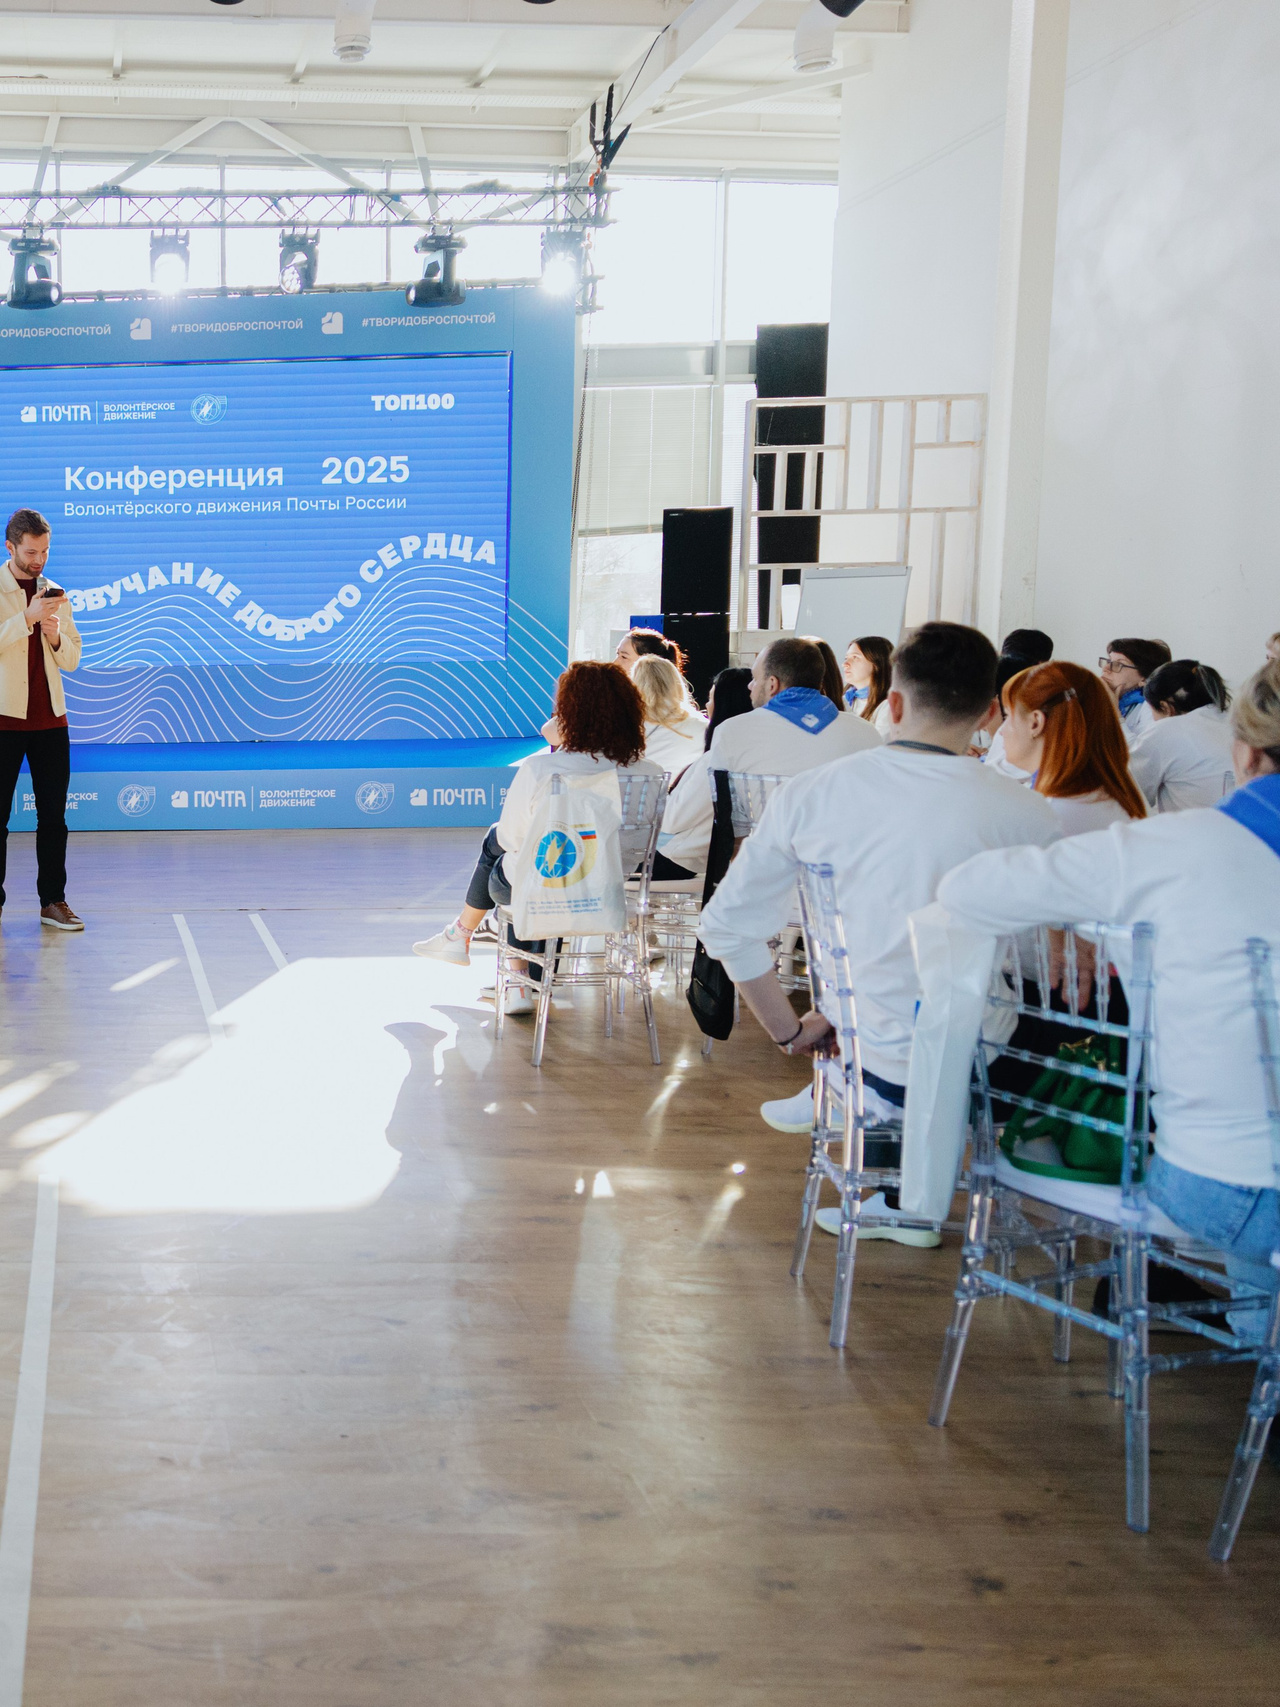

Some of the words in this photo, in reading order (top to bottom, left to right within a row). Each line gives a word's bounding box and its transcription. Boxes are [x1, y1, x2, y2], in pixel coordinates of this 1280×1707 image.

[171, 318, 303, 333] #ТВОРИДОБРОСПОЧТОЙ
[362, 312, 496, 328] #ТВОРИДОБРОСПОЧТОЙ
[103, 401, 175, 412] ВОЛОНТЁРСКОЕ
[371, 393, 455, 411] ТОП100
[41, 404, 91, 422] ПОЧТА
[103, 411, 156, 422] ДВИЖЕНИЕ
[64, 465, 284, 496] Конференция
[321, 455, 410, 485] 2025
[64, 501, 192, 518] Волонтёрского
[196, 500, 281, 515] движения
[287, 497, 339, 511] Почты
[346, 496, 407, 510] России
[67, 562, 242, 612] ЗВУЧАНИЕ
[233, 584, 362, 642] ДОБРОГО
[359, 532, 496, 583] СЕРДЦА
[23, 792, 98, 801] ВОРСКОЕ
[194, 790, 247, 808] ПОЧТА
[259, 787, 336, 798] ВОЛОНТЁРСКОЕ
[433, 788, 487, 806] ПОЧТА
[259, 798, 316, 808] ДВИЖЕНИЕ
